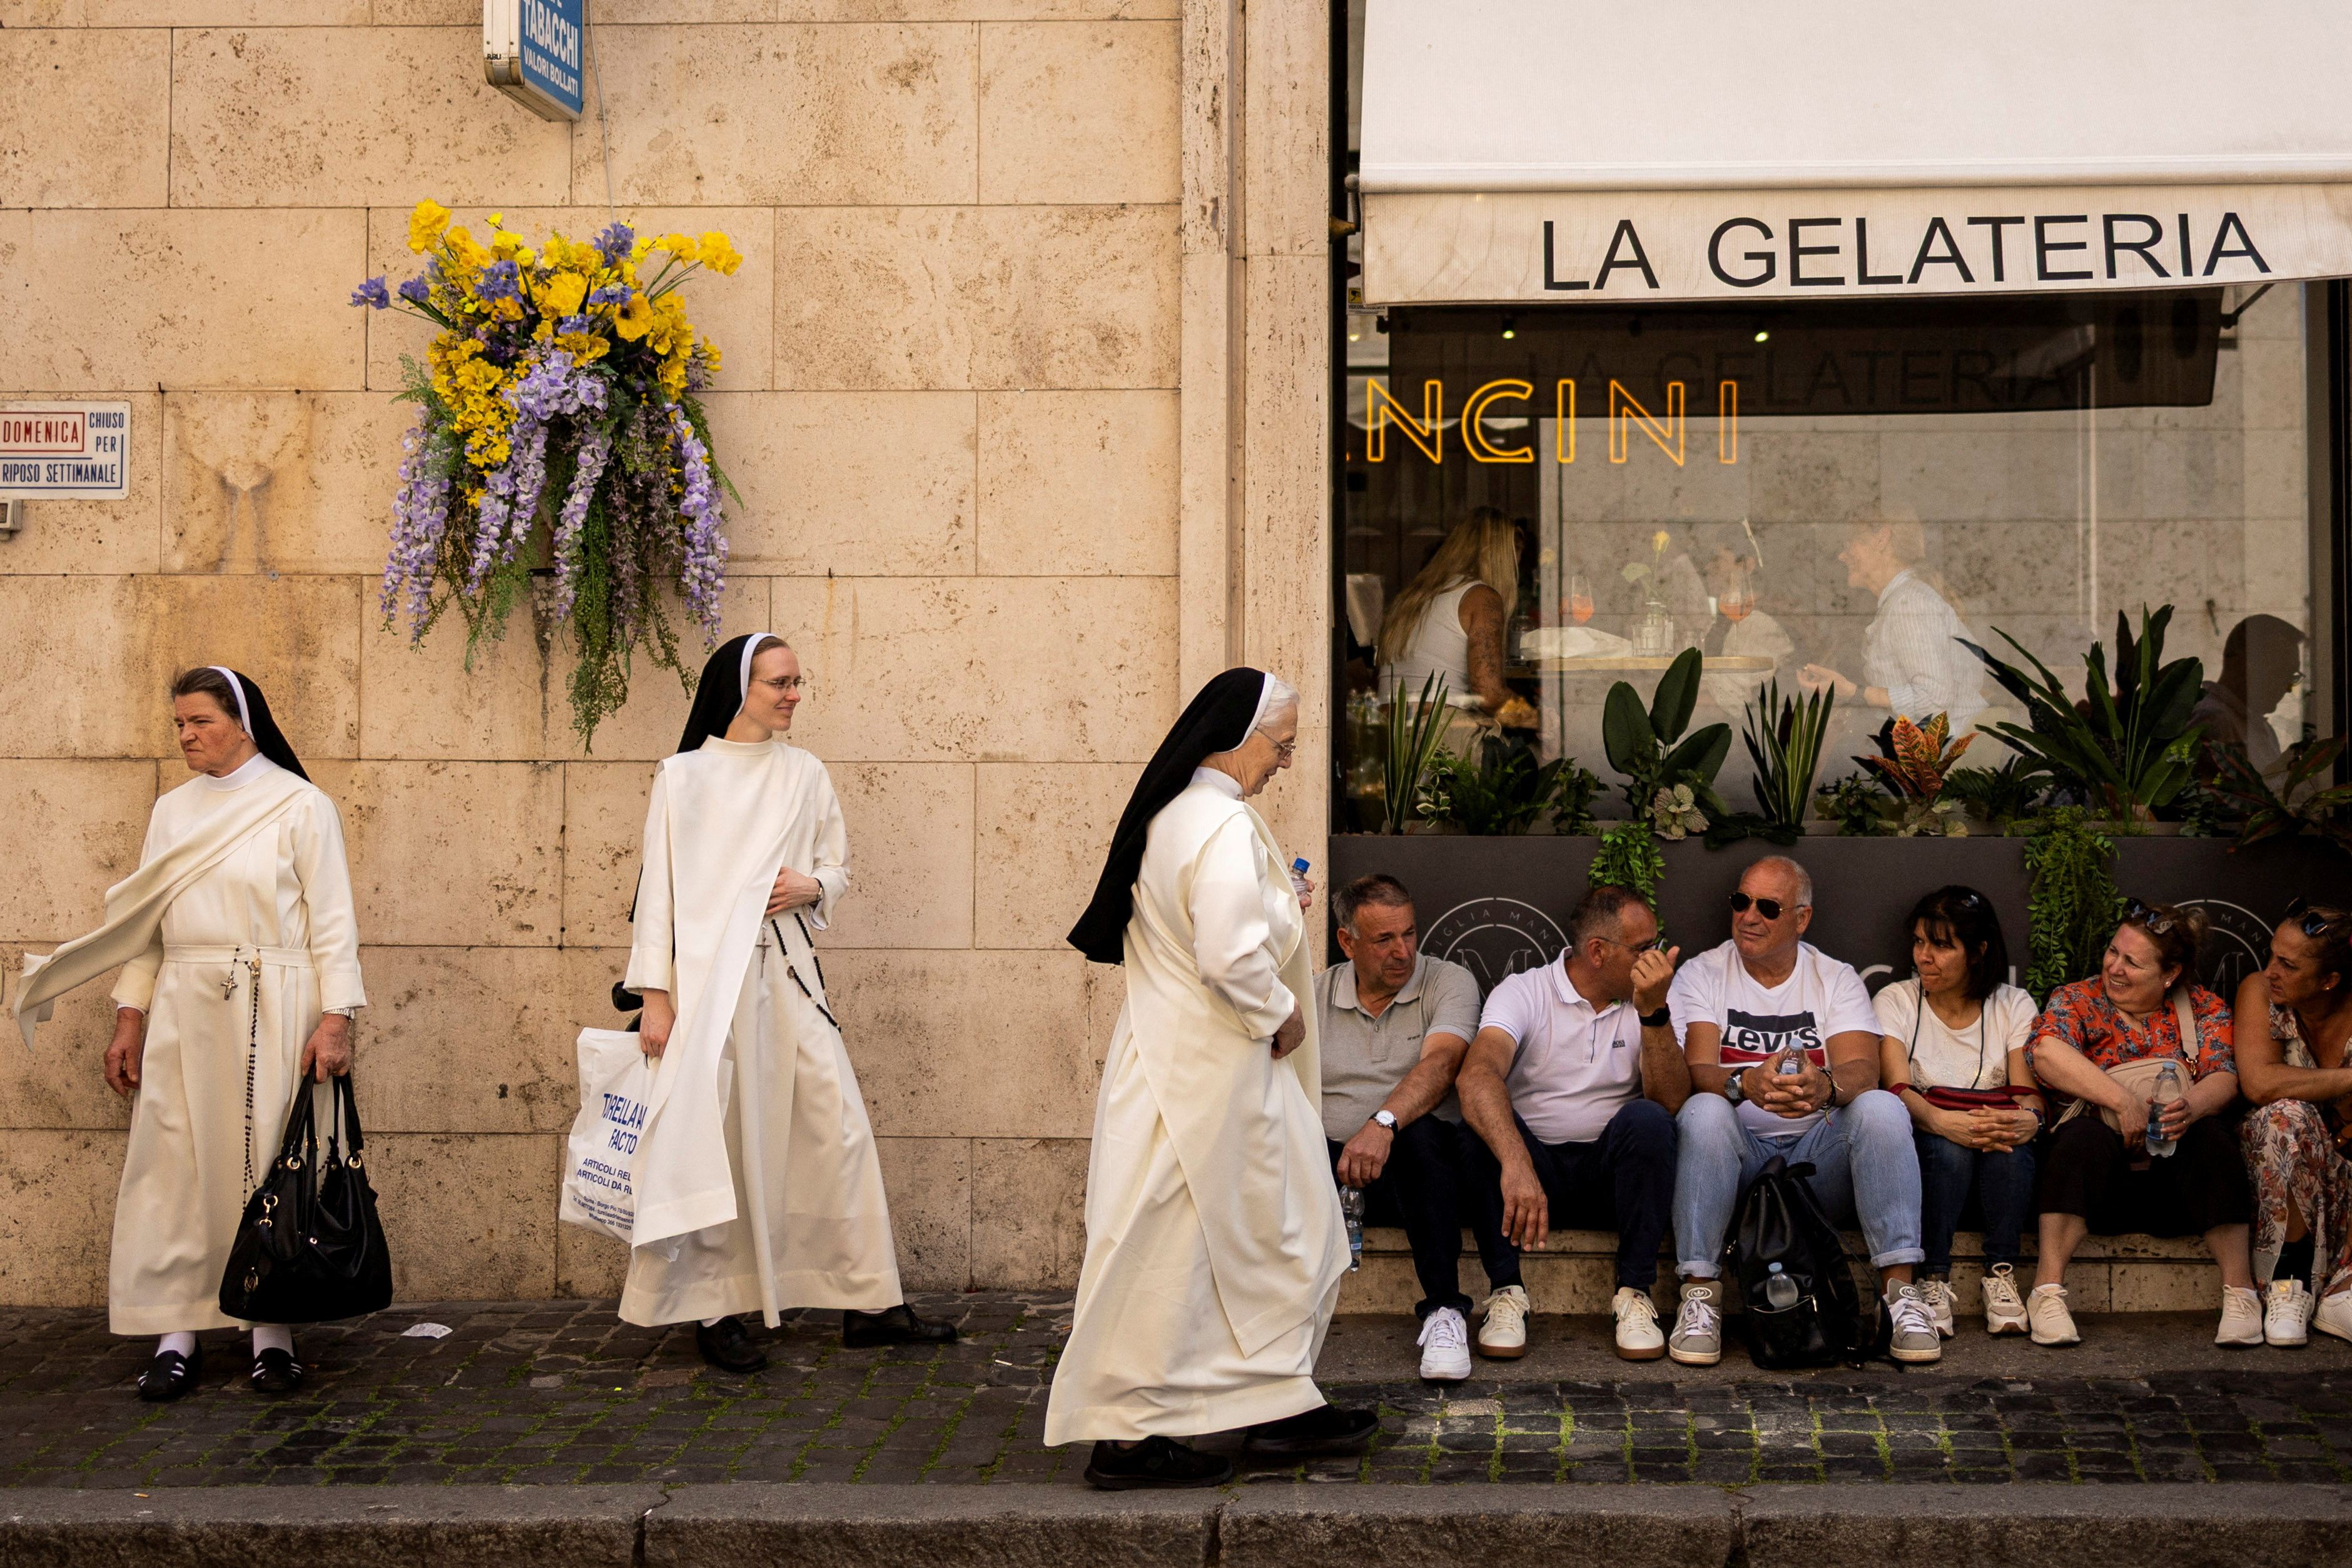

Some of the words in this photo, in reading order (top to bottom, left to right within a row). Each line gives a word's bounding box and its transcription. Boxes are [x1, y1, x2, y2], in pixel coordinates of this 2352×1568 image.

[524, 0, 579, 71] TABACCHI
[524, 44, 549, 79] VALORI
[550, 64, 578, 98] BOLLATI
[1543, 220, 1660, 290] LA
[1707, 212, 2272, 288] GELATERIA
[3, 420, 79, 443] DOMENICA
[89, 412, 124, 429] CHIUSO
[1347, 378, 1736, 467] NCINI
[96, 436, 116, 452] PER
[3, 463, 40, 483] RIPOSO
[46, 463, 116, 483] SETTIMANALE
[608, 1128, 637, 1155] FACTO
[582, 1158, 616, 1176] ARTICOLI
[577, 1169, 610, 1187] ARTICOLI
[611, 1181, 622, 1191] DA
